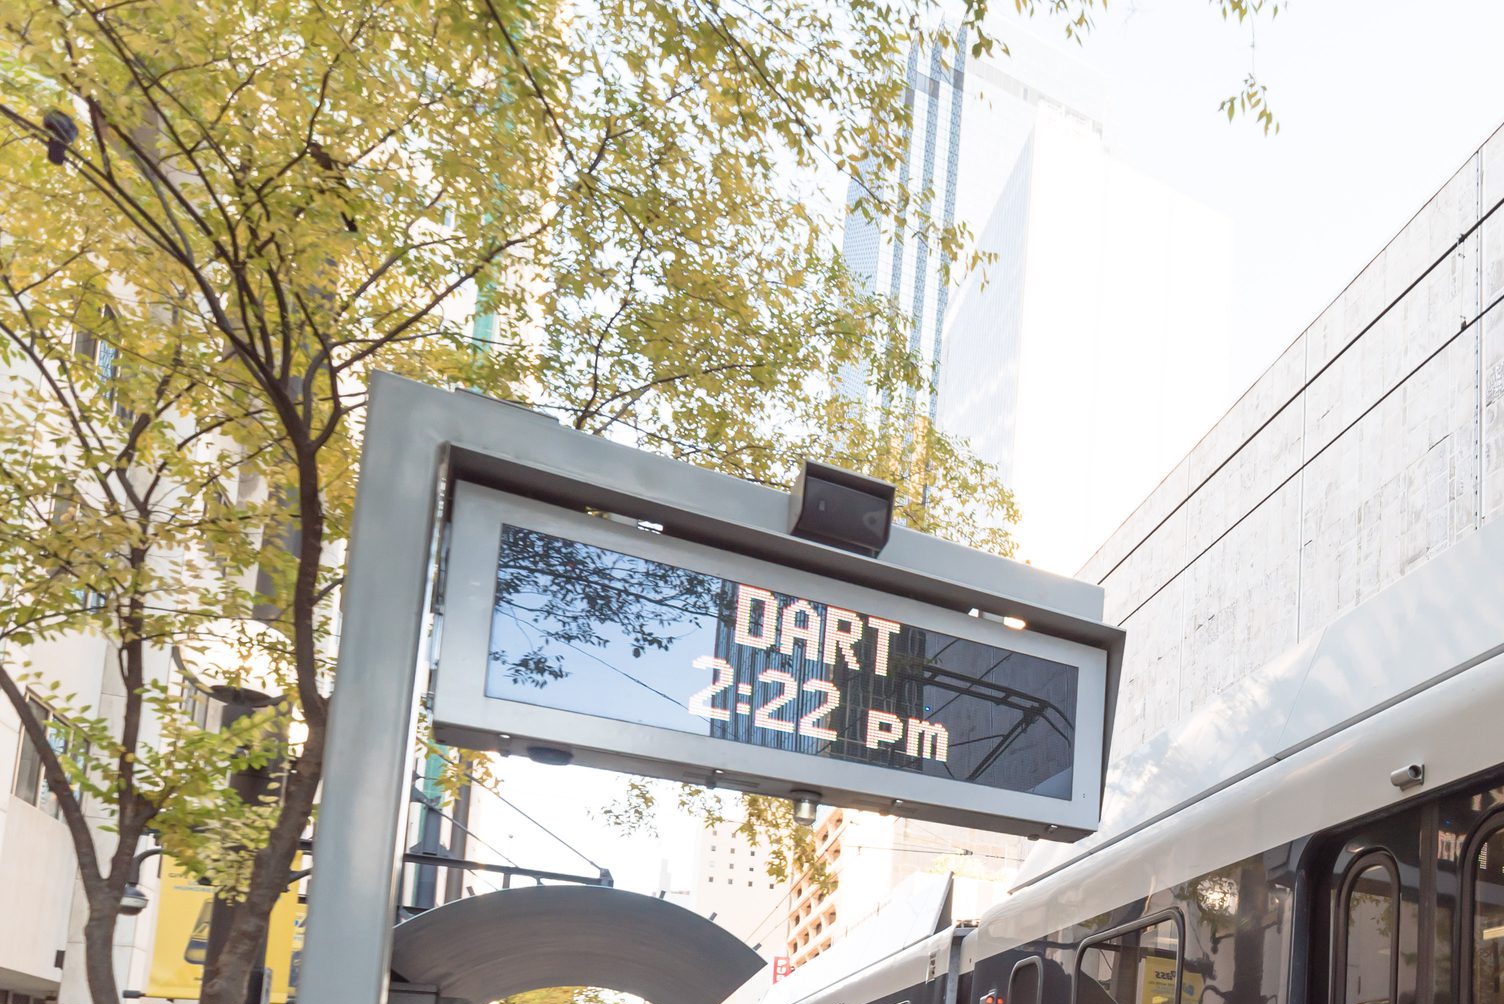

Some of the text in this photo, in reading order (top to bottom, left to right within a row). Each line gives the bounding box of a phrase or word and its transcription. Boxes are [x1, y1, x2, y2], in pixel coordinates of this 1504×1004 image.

[734, 584, 900, 676] DART
[688, 655, 949, 762] 2:22 pm
